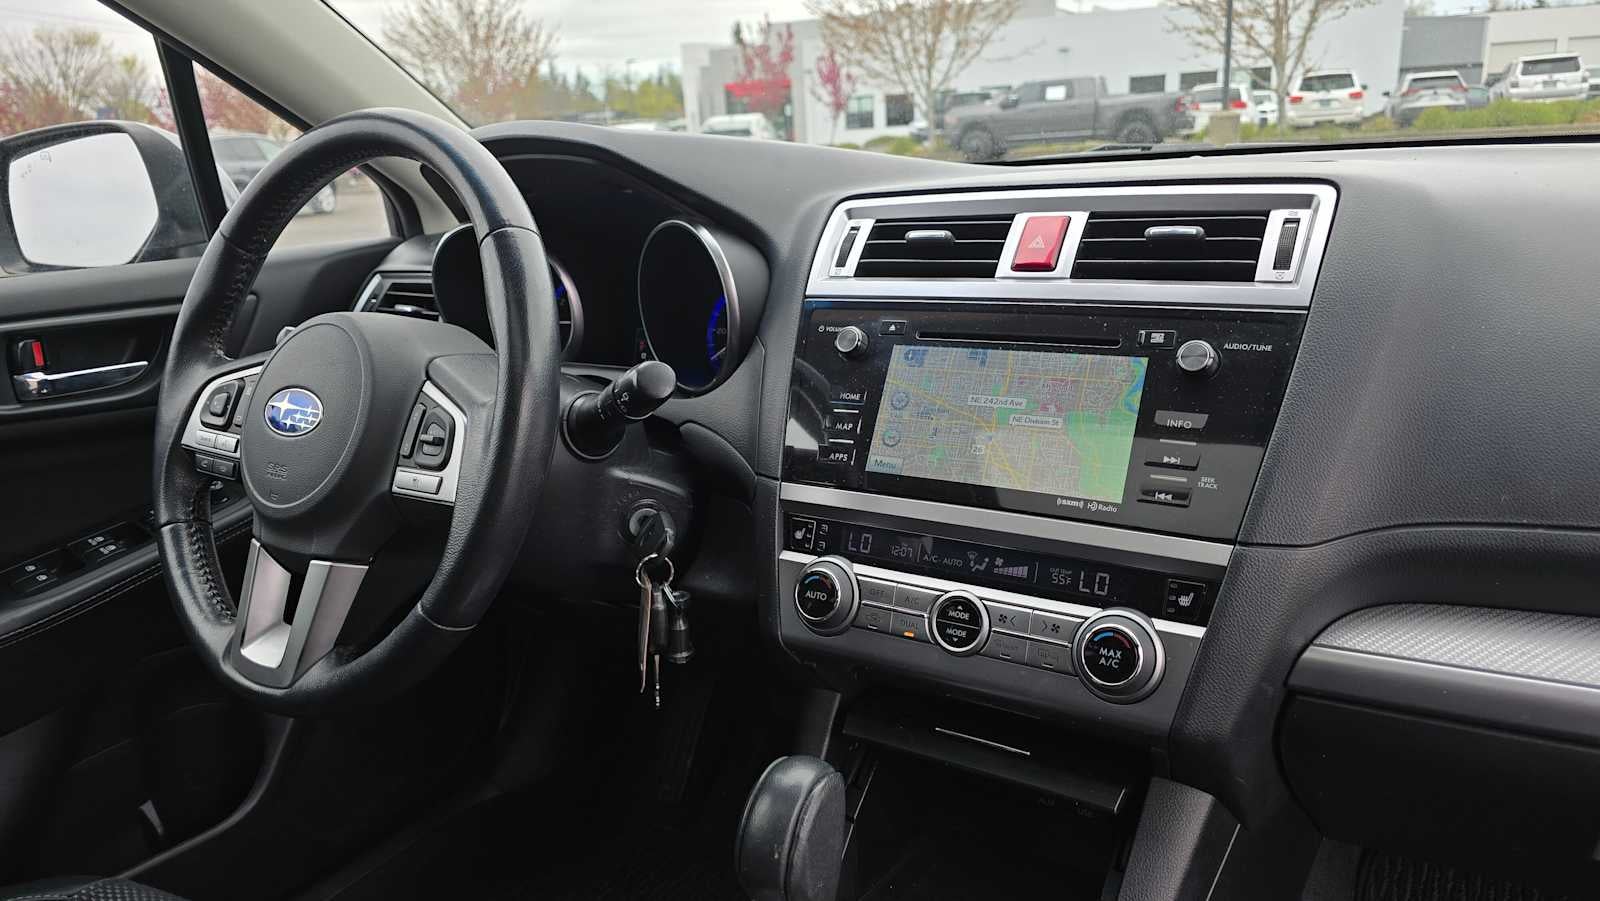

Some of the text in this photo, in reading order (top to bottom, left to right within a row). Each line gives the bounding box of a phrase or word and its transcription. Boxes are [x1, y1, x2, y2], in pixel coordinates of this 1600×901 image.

[1223, 343, 1273, 352] AUDIO/TUNE
[1167, 419, 1192, 428] INFO
[829, 453, 848, 461] APPS
[1098, 504, 1117, 512] Radio
[848, 532, 872, 553] LO
[1079, 571, 1110, 596] LO
[805, 590, 827, 600] AUTO
[948, 610, 970, 620] MODE
[946, 628, 967, 637] MODE
[1099, 648, 1122, 659] MAX
[1099, 658, 1120, 668] A/C
